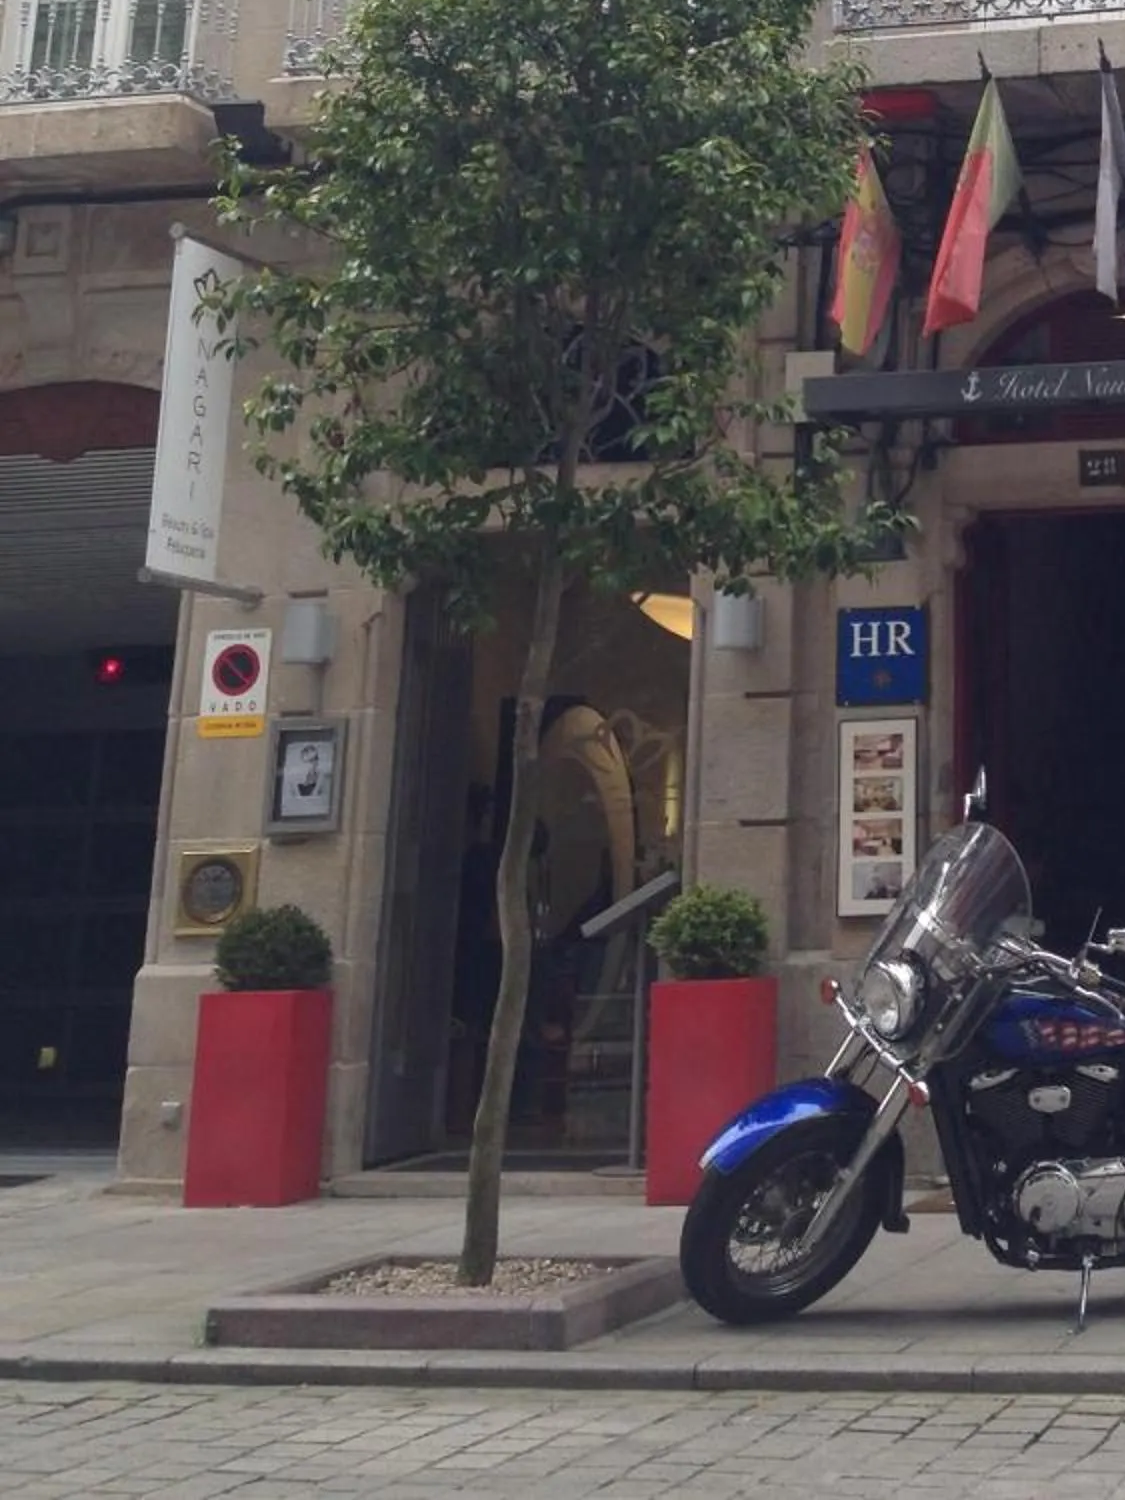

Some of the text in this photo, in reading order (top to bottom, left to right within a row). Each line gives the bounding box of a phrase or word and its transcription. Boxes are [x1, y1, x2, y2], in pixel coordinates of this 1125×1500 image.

[995, 368, 1069, 399] Hotel
[186, 337, 213, 502] NAGARI
[850, 620, 915, 658] HR
[209, 700, 257, 713] VADO
